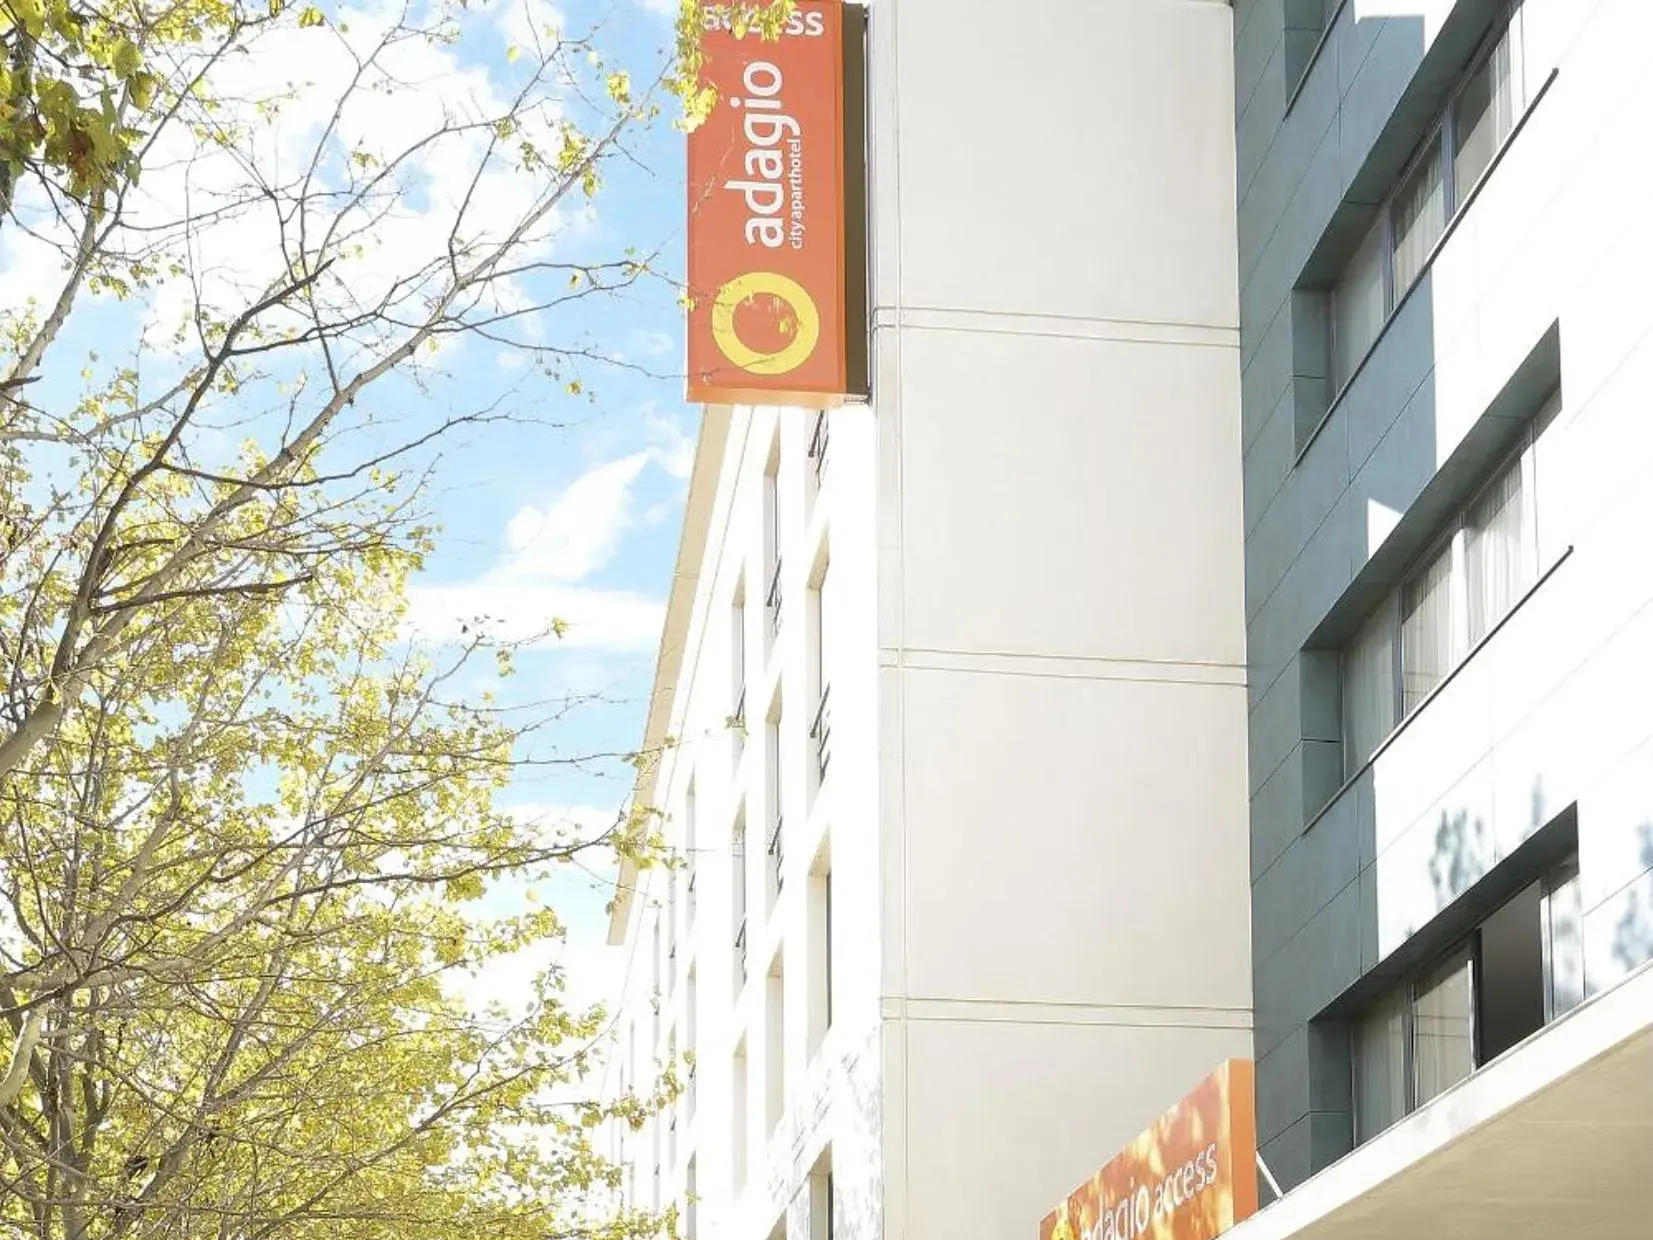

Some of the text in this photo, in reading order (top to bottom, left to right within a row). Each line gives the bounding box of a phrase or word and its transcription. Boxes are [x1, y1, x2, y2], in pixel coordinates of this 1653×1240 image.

[723, 61, 801, 248] adagio
[786, 138, 806, 250] city aparthotel
[1153, 1143, 1218, 1217] access
